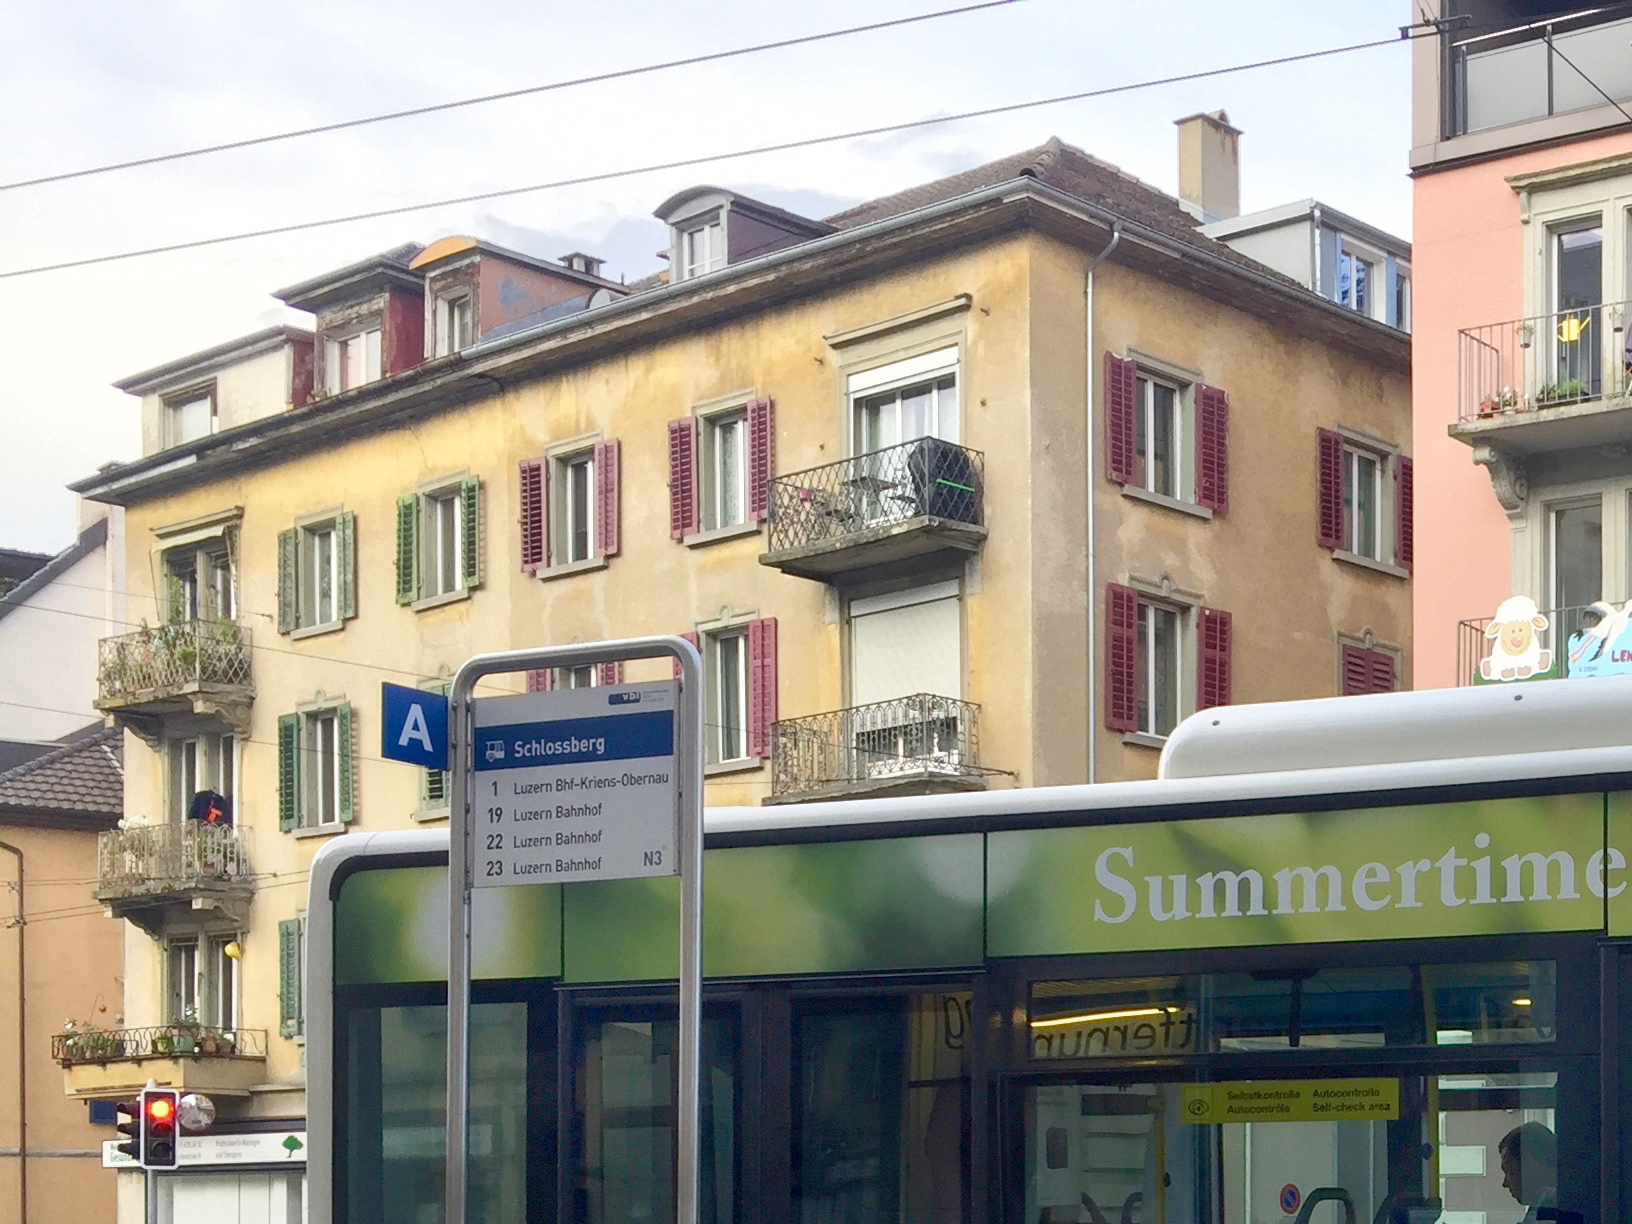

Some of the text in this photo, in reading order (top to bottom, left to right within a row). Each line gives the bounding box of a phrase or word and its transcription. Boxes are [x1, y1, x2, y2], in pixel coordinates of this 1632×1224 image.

[398, 703, 434, 752] A
[513, 736, 605, 758] Schlossberg
[491, 773, 669, 797] 1 Luzern Bhf-Kriens-Obernau
[487, 803, 602, 824] 19 Luzern Bahnhof
[486, 830, 602, 851] 22 Luzern Bahnhof
[486, 857, 602, 877] 23 Luzern Bahnhof
[643, 850, 663, 867] N3
[1093, 831, 1627, 924] Summertime
[1312, 1101, 1391, 1113] Self-check area
